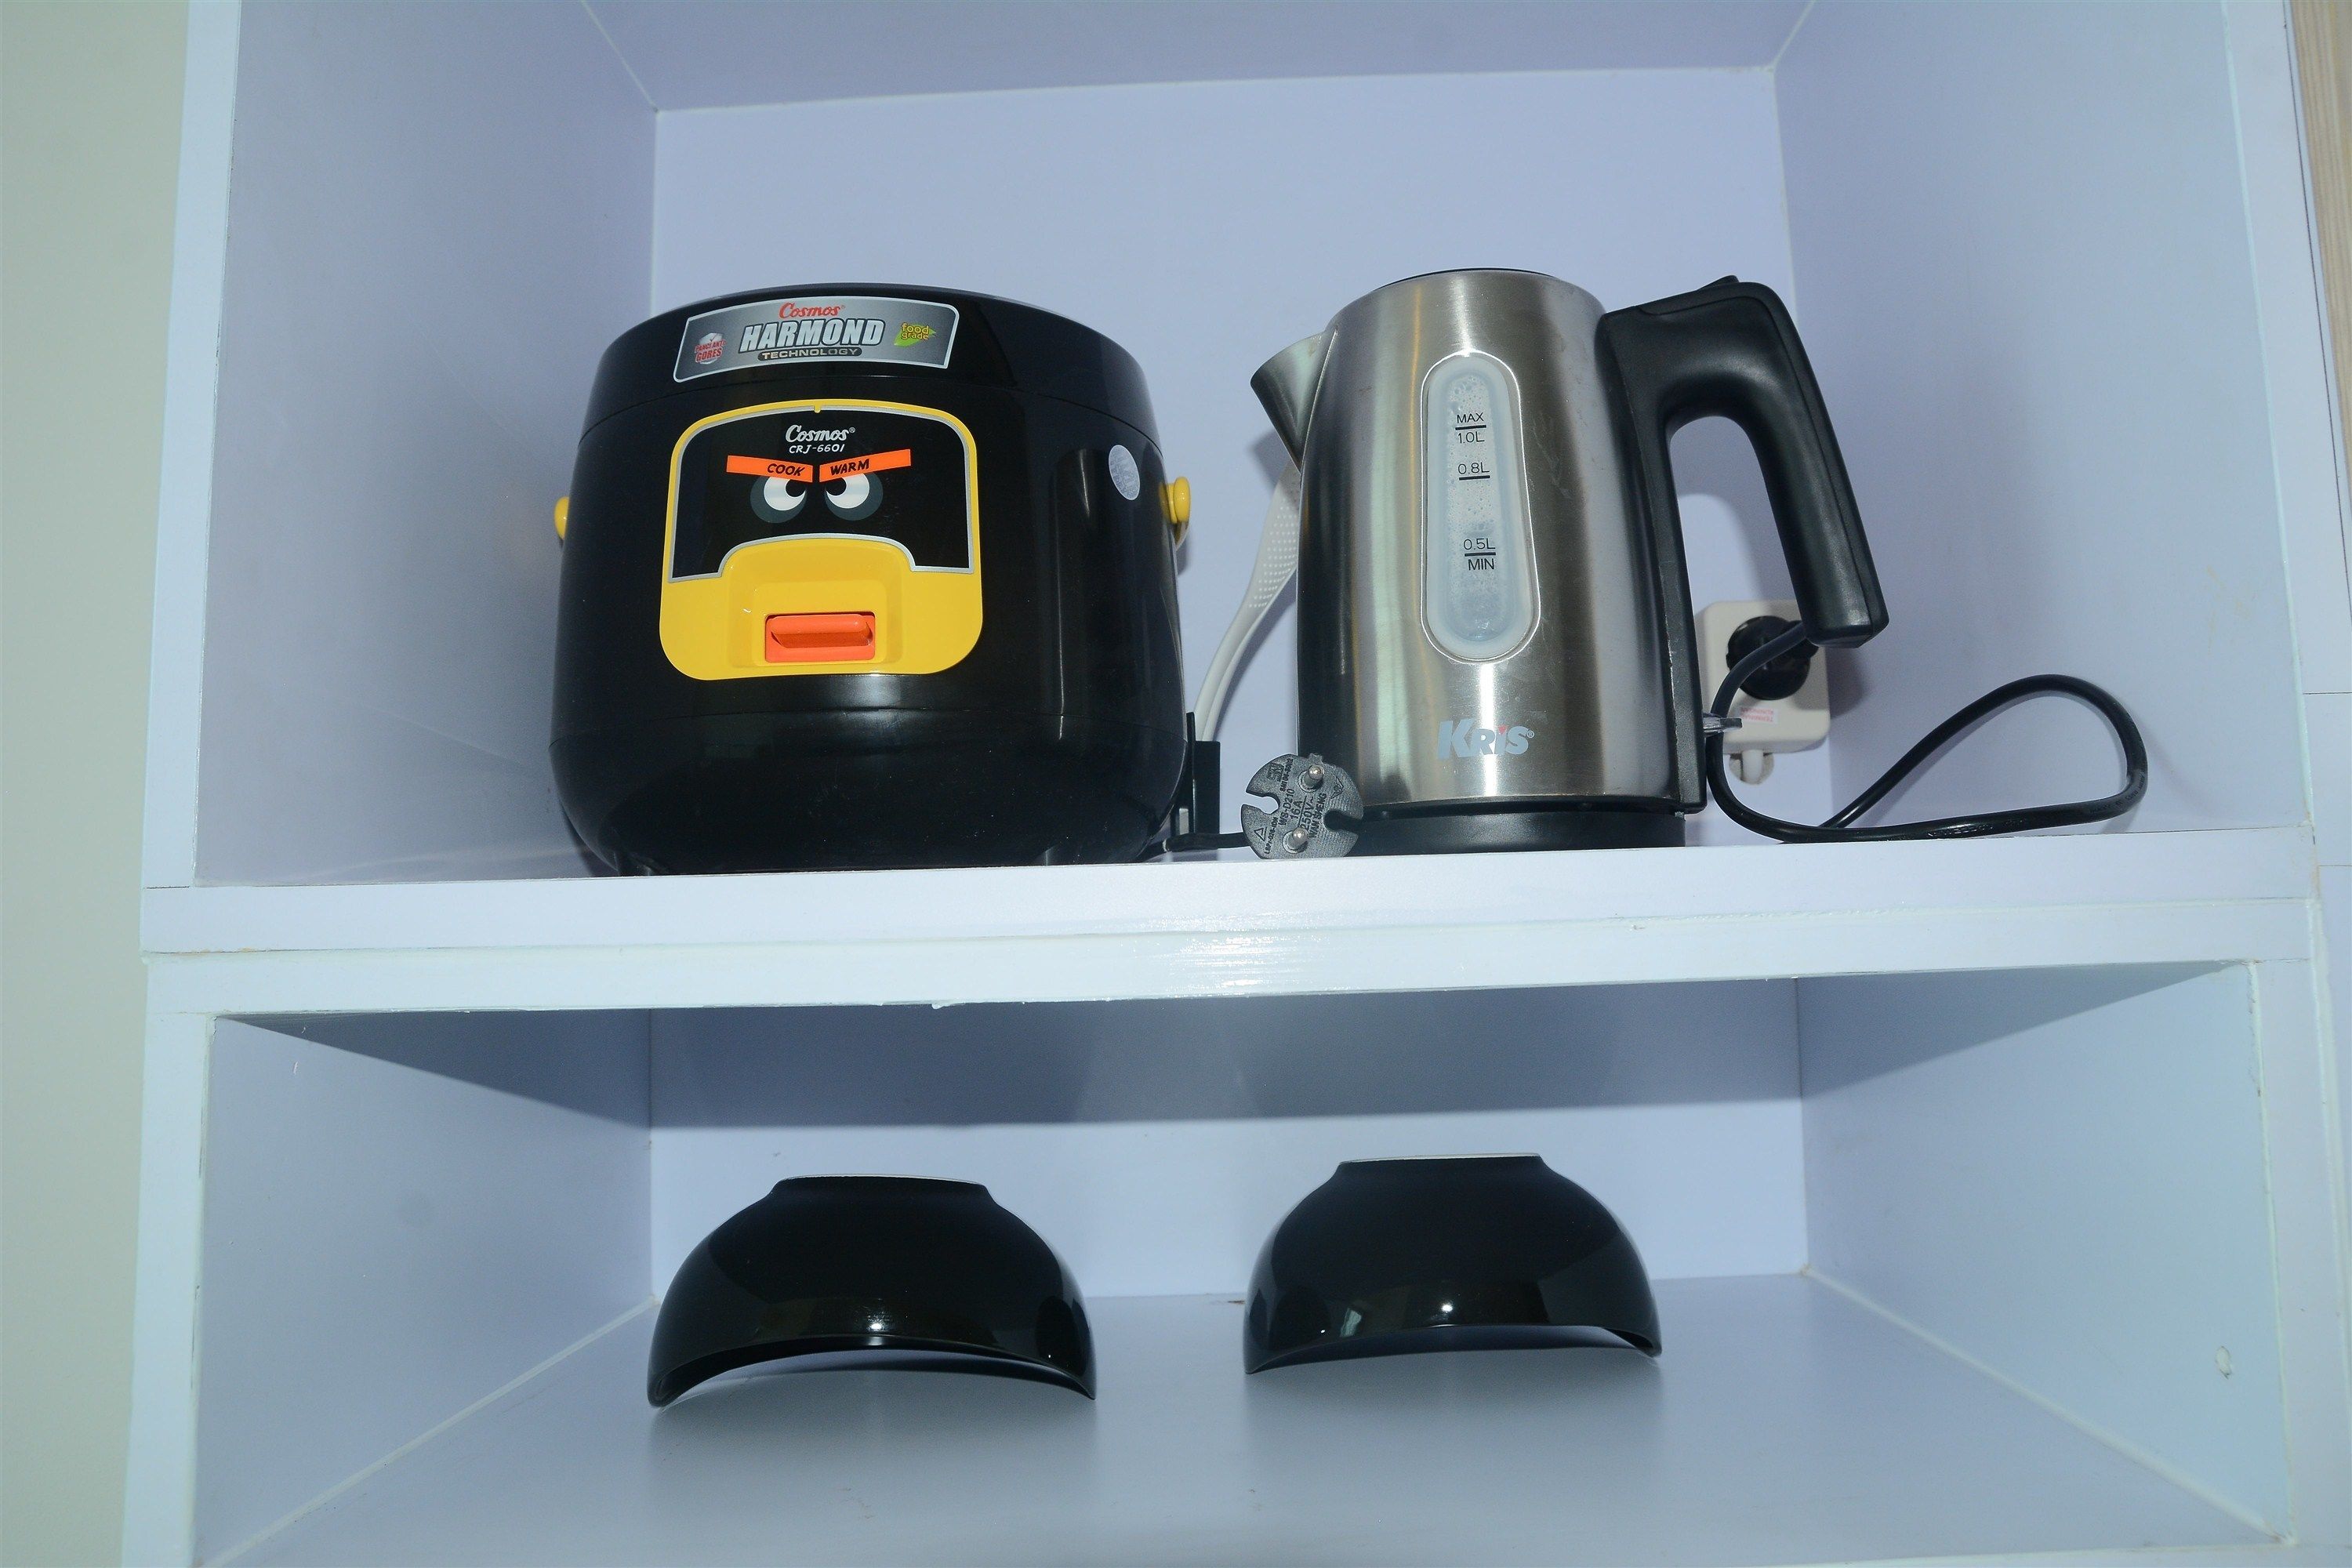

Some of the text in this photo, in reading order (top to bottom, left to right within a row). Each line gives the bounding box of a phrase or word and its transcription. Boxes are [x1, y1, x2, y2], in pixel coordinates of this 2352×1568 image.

[779, 302, 846, 320] Cosmos
[902, 322, 929, 334] food
[739, 319, 884, 353] HARMOND
[901, 332, 928, 340] grade
[760, 348, 858, 359] TECHNOLOGY
[1457, 412, 1484, 423] MAX
[785, 424, 850, 443] Cosmos
[1457, 431, 1485, 444] 1.0L
[789, 444, 845, 454] CRJ-6601
[767, 463, 806, 477] COOK
[829, 458, 870, 476] WARM
[1457, 462, 1490, 475] 0.8L
[1463, 538, 1496, 550] 0.5L
[1468, 558, 1495, 571] MIN
[1278, 788, 1295, 826] WS-D210
[1290, 800, 1303, 819] 16A
